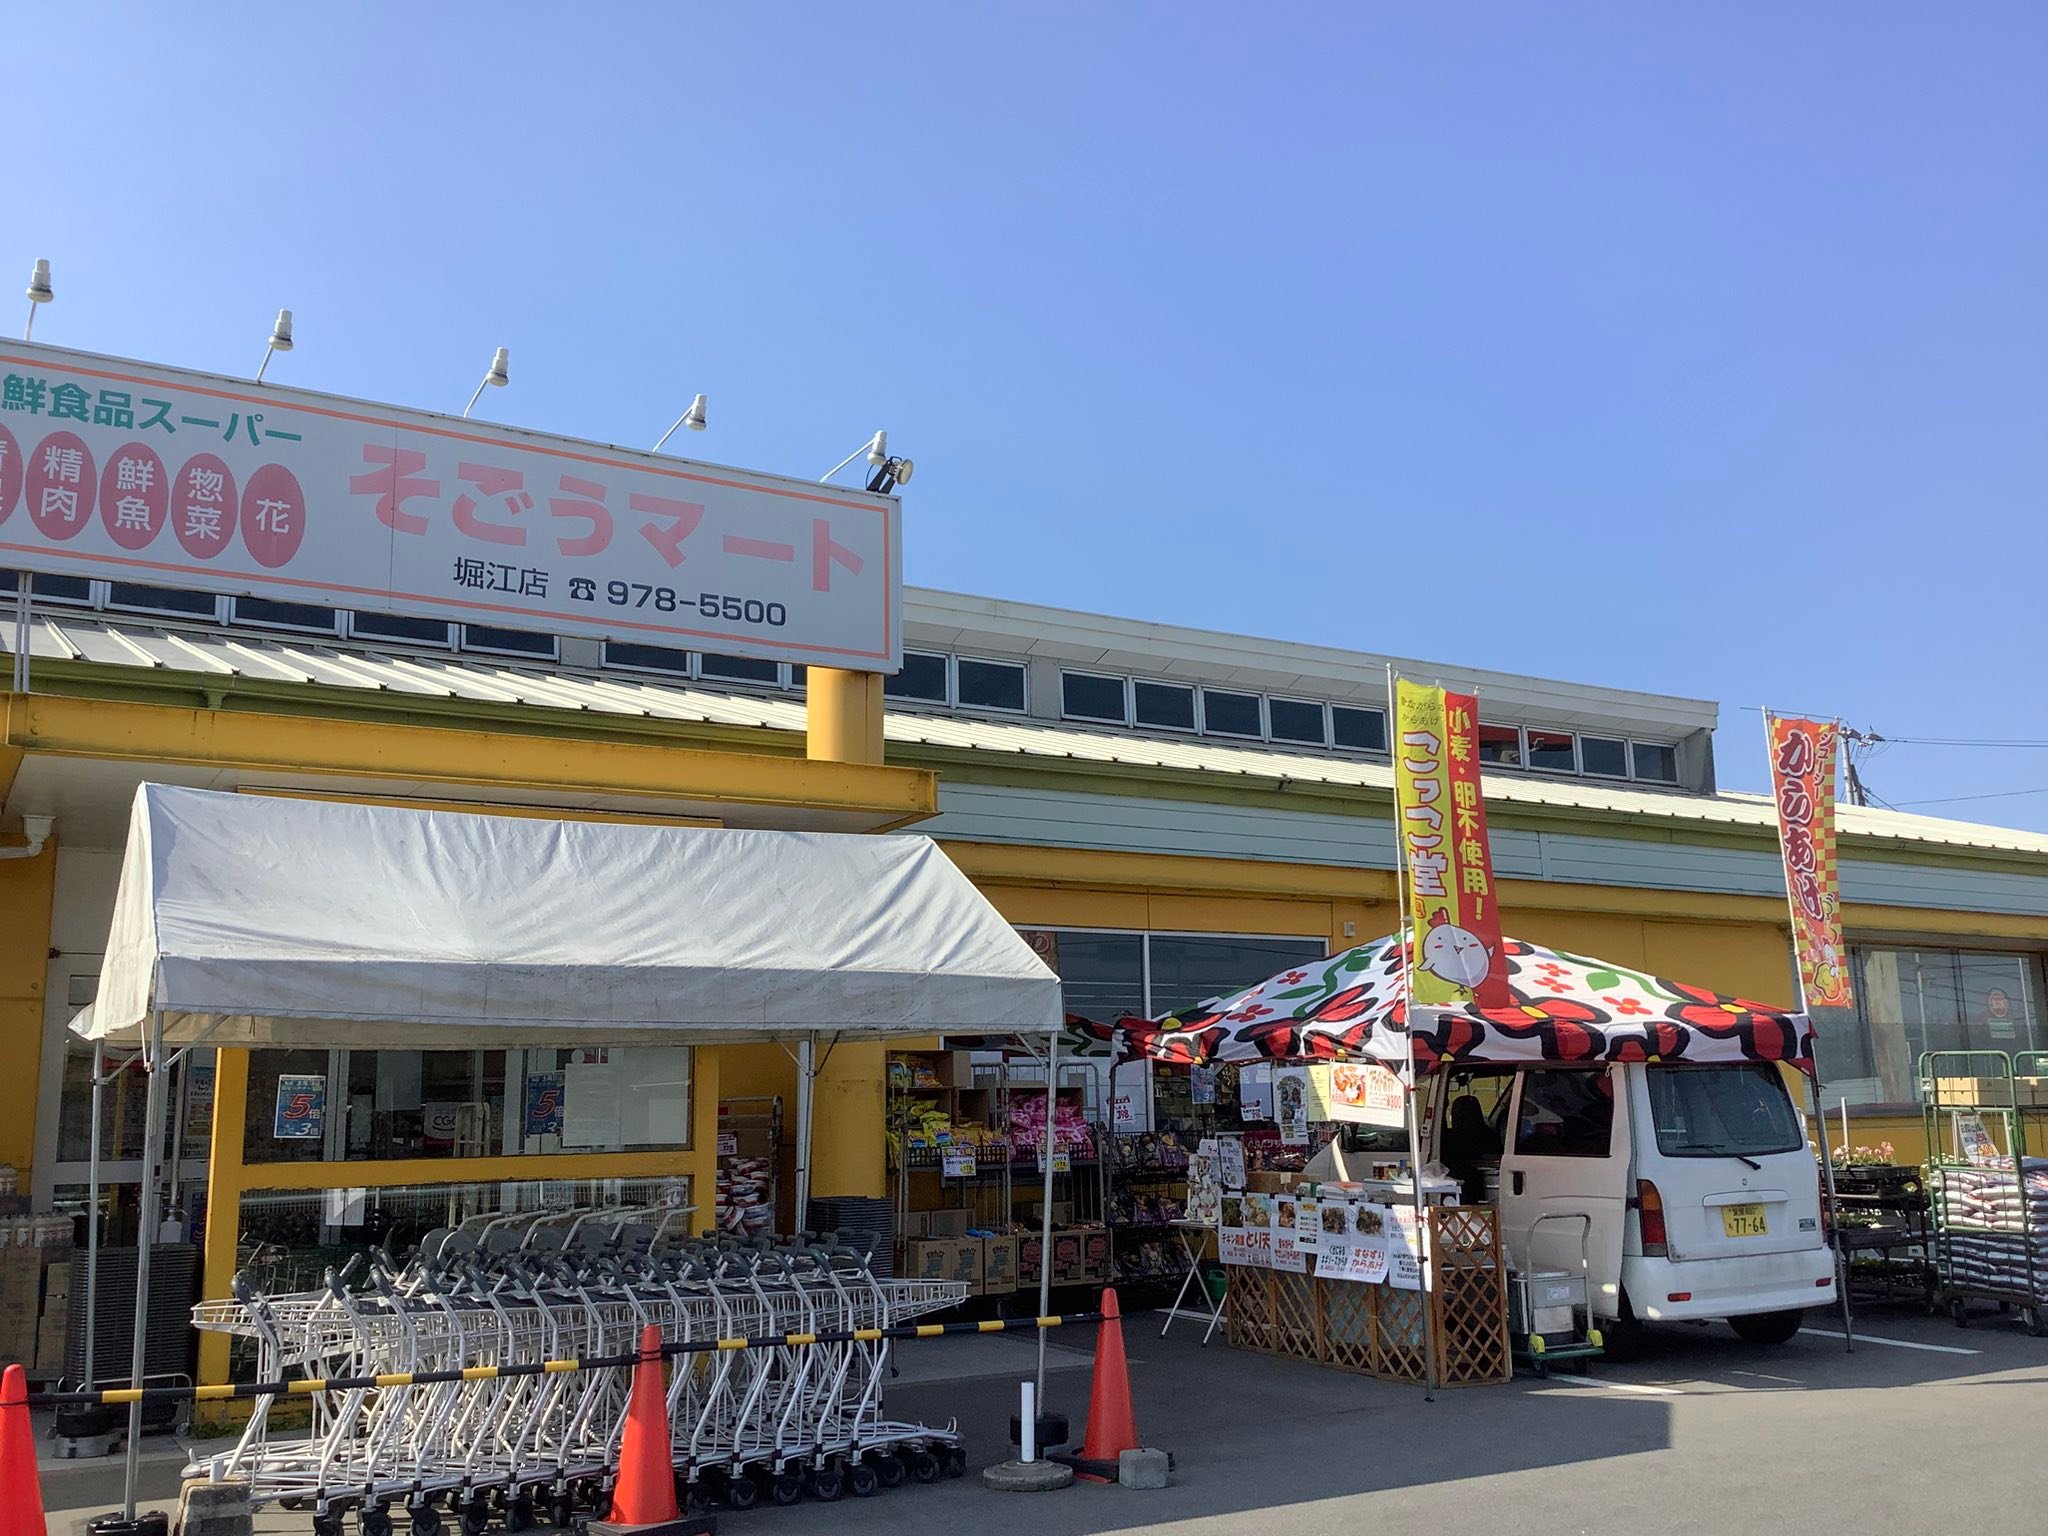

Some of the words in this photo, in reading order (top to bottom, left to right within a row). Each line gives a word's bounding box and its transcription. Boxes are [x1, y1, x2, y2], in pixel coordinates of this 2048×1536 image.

[2, 373, 302, 446] 鮮食品スーパー
[40, 445, 83, 522] 精肉
[115, 456, 154, 531] 鮮魚
[184, 467, 224, 541] 惣菜
[254, 498, 292, 535] 花
[349, 444, 865, 593] そごうマート
[453, 556, 549, 599] 堀江店
[606, 580, 787, 627] 978-5500
